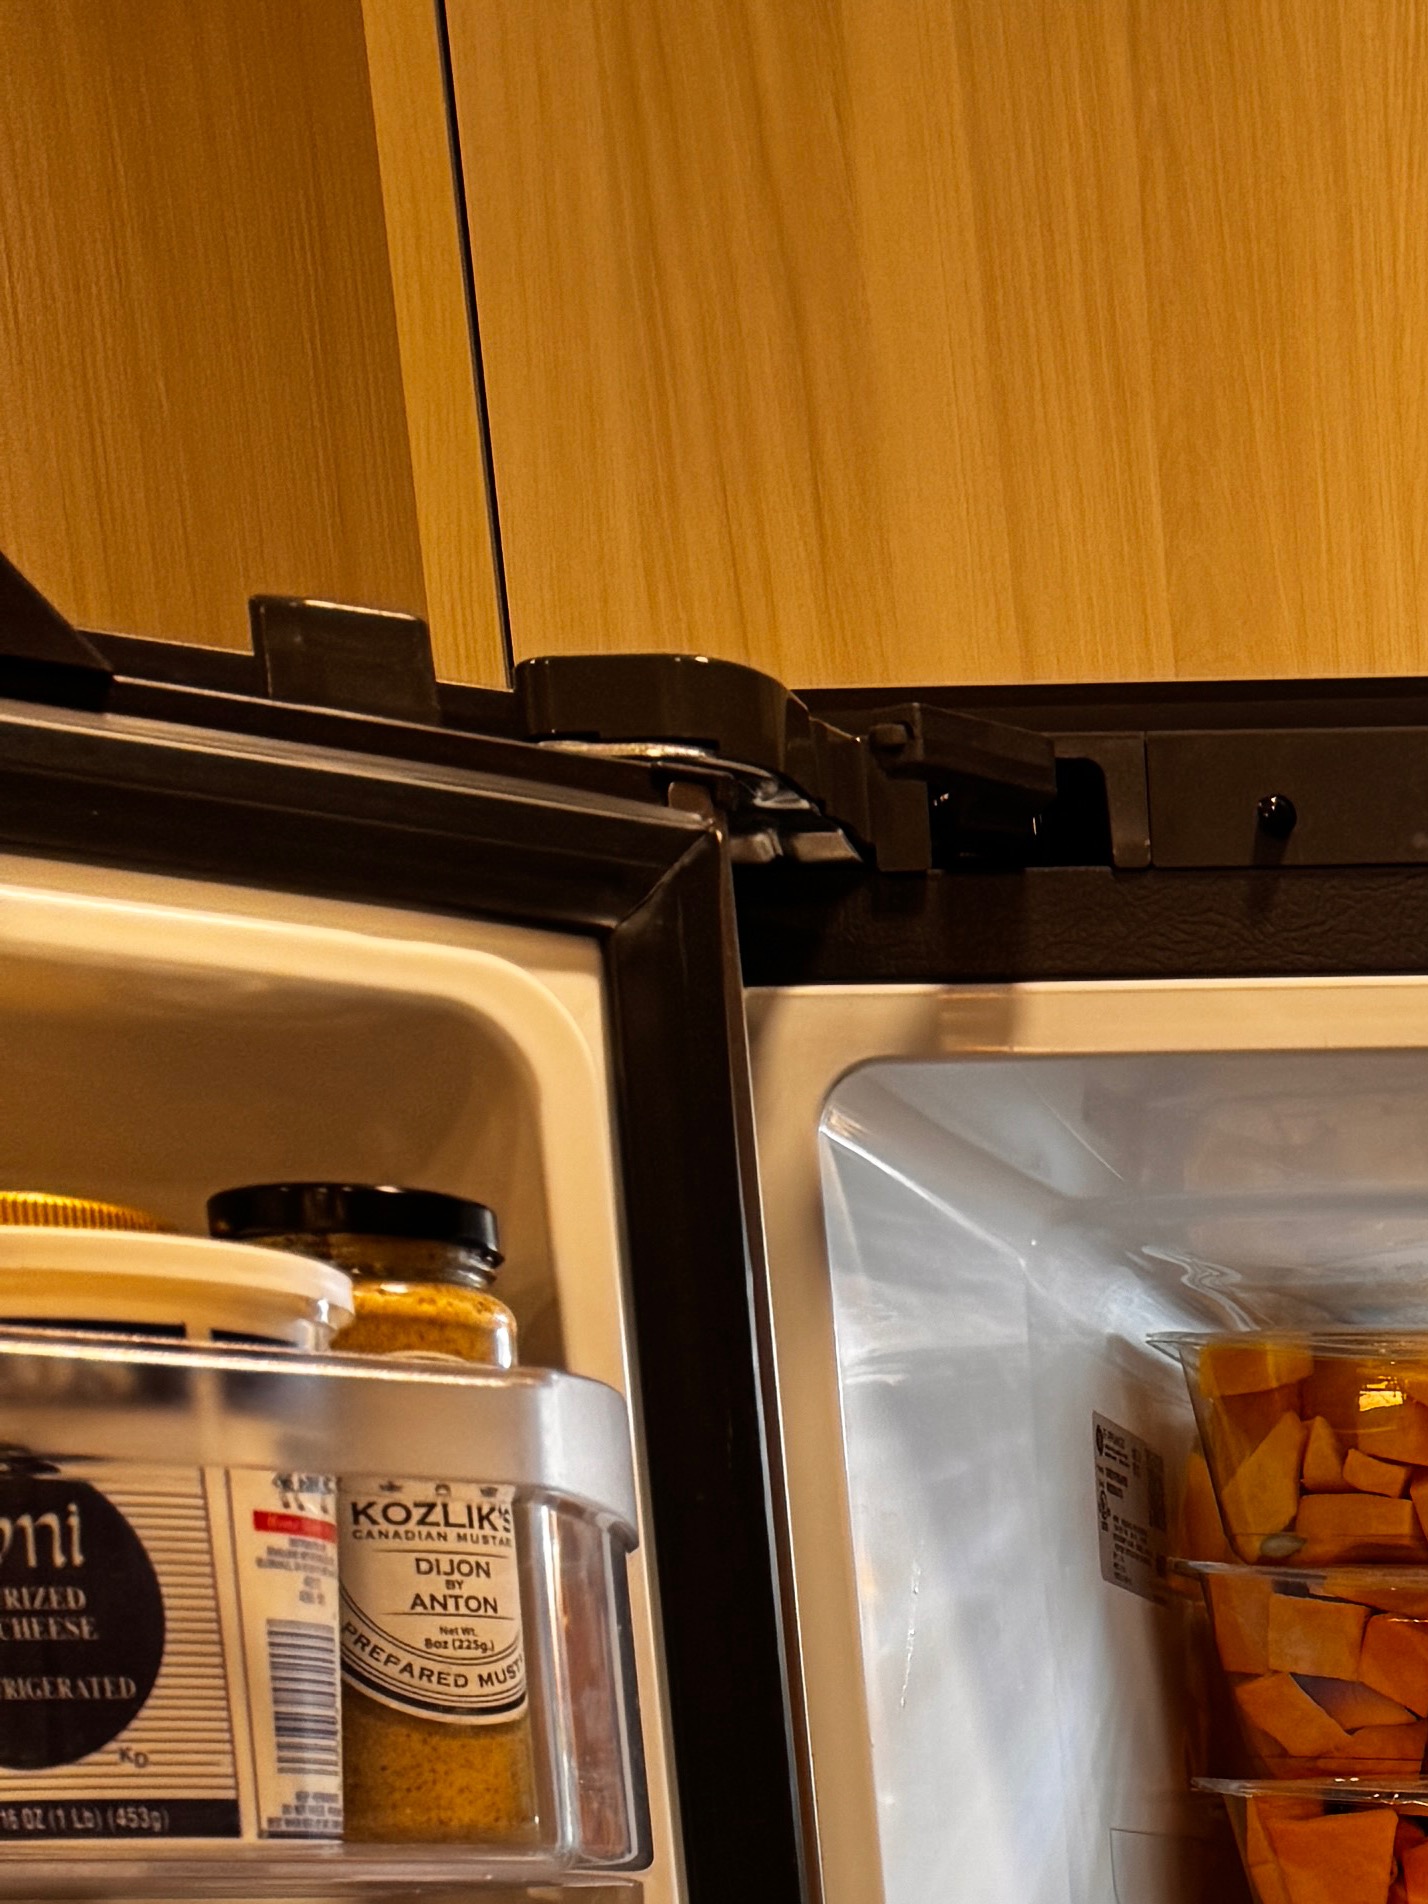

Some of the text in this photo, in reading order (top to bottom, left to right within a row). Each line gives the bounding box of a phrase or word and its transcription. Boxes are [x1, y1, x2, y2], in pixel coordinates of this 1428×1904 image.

[352, 1529, 448, 1542] CANADIAN
[415, 1557, 491, 1579] DIJON
[445, 1579, 463, 1591] BY
[410, 1592, 499, 1614] ANTON
[342, 1622, 468, 1688] PREPARED
